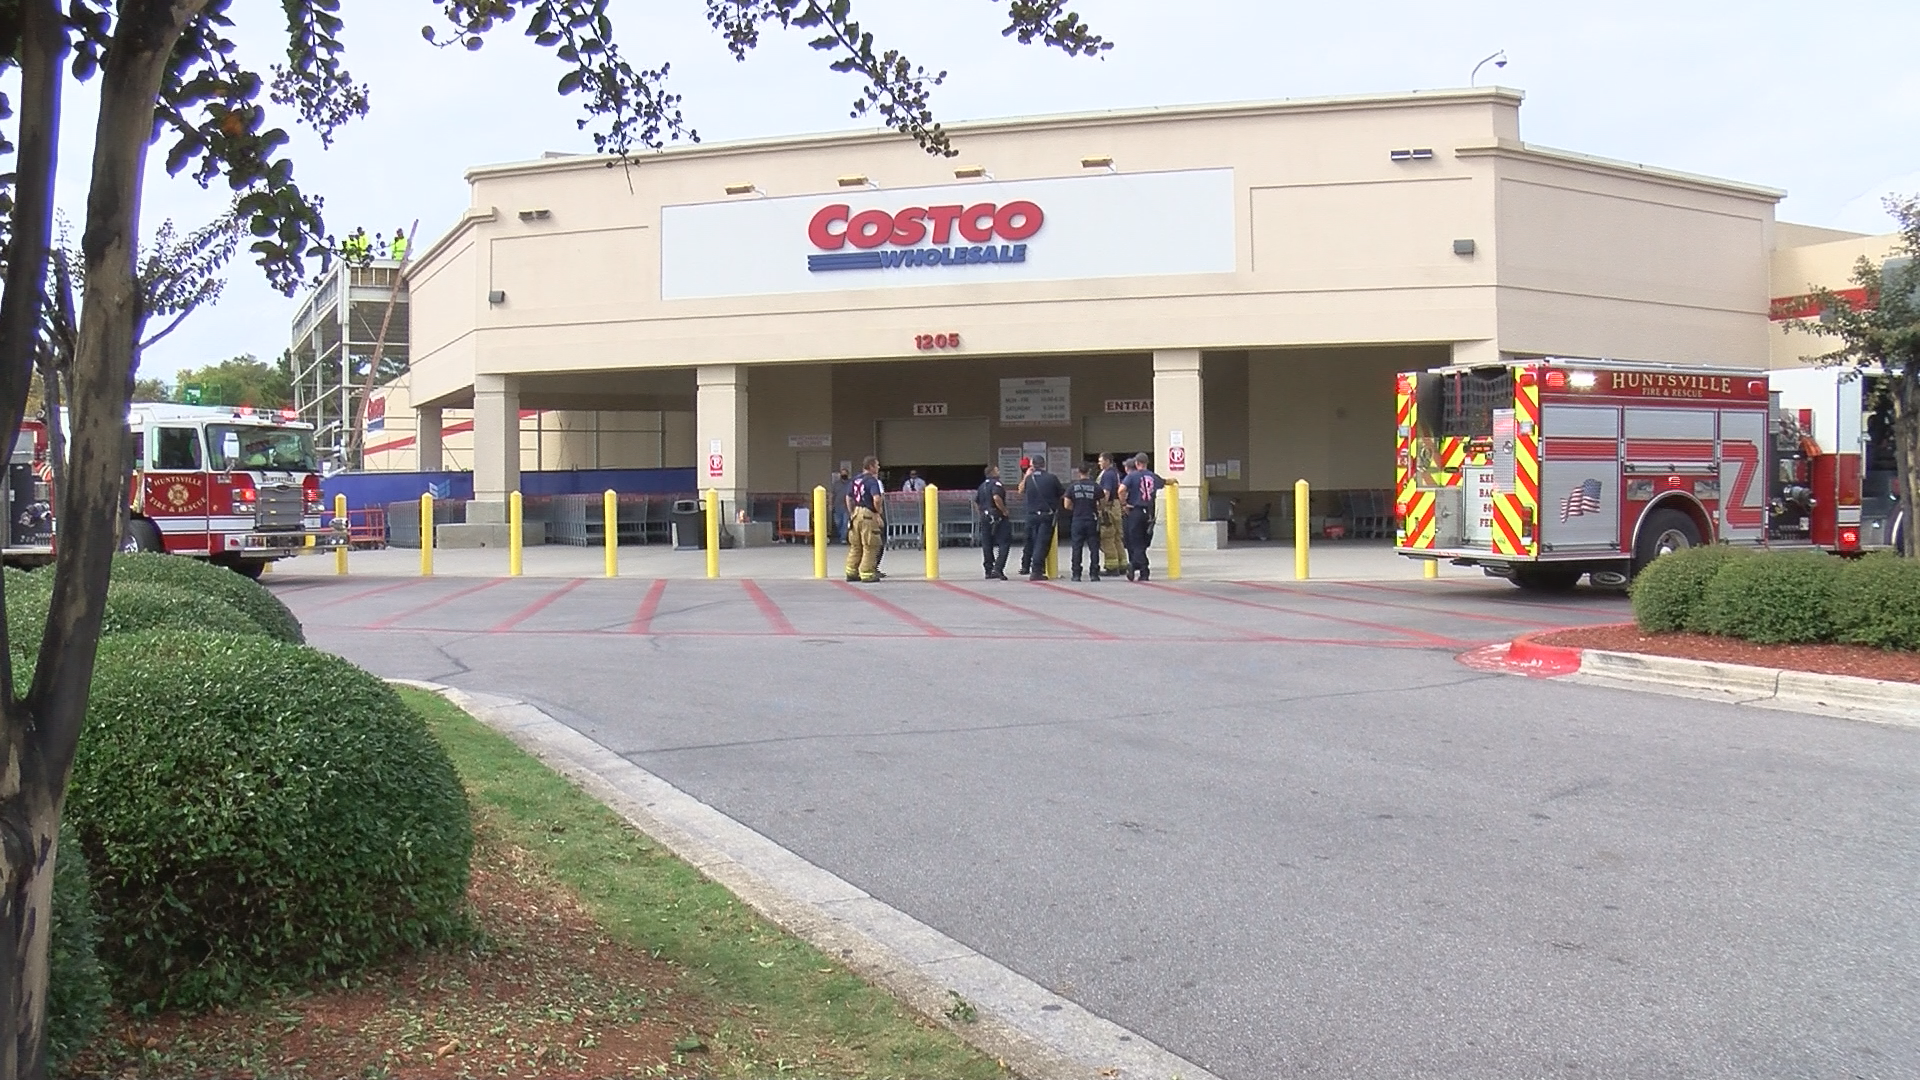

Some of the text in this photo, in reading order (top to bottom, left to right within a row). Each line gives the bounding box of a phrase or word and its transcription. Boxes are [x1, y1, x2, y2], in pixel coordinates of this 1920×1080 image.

[808, 201, 1044, 250] COSTCO
[880, 244, 1027, 268] WHOLESALE
[914, 333, 960, 350] 1205
[1612, 372, 1731, 394] HUNTSVILLE
[1642, 387, 1660, 396] FIRE
[1672, 389, 1703, 398] RESCUE
[917, 404, 944, 414] EXIT
[1107, 401, 1154, 411] ENTRA
[154, 476, 203, 487] HUNTSVILLE
[1479, 474, 1494, 483] KEE
[1479, 488, 1494, 497] BAC
[149, 497, 167, 511] FIRE
[178, 496, 207, 513] RESCUE
[1479, 518, 1493, 527] FEE
